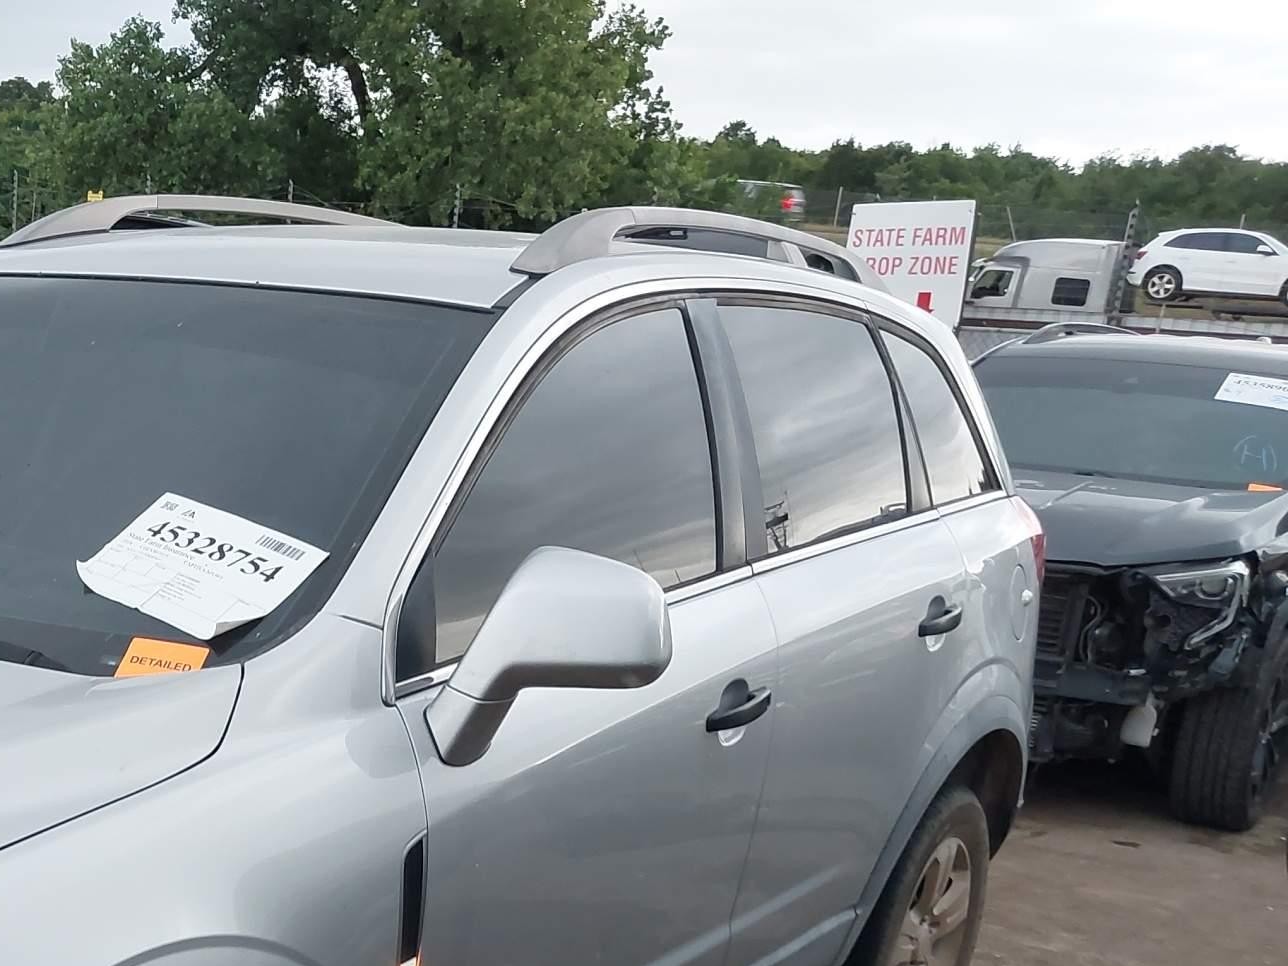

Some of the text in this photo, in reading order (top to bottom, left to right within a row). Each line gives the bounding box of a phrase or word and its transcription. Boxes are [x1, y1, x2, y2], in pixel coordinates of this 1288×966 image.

[852, 226, 967, 248] STATE FARM
[865, 255, 960, 276] ROP ZONE
[146, 521, 285, 583] 45328754
[129, 655, 192, 673] DETAILED
